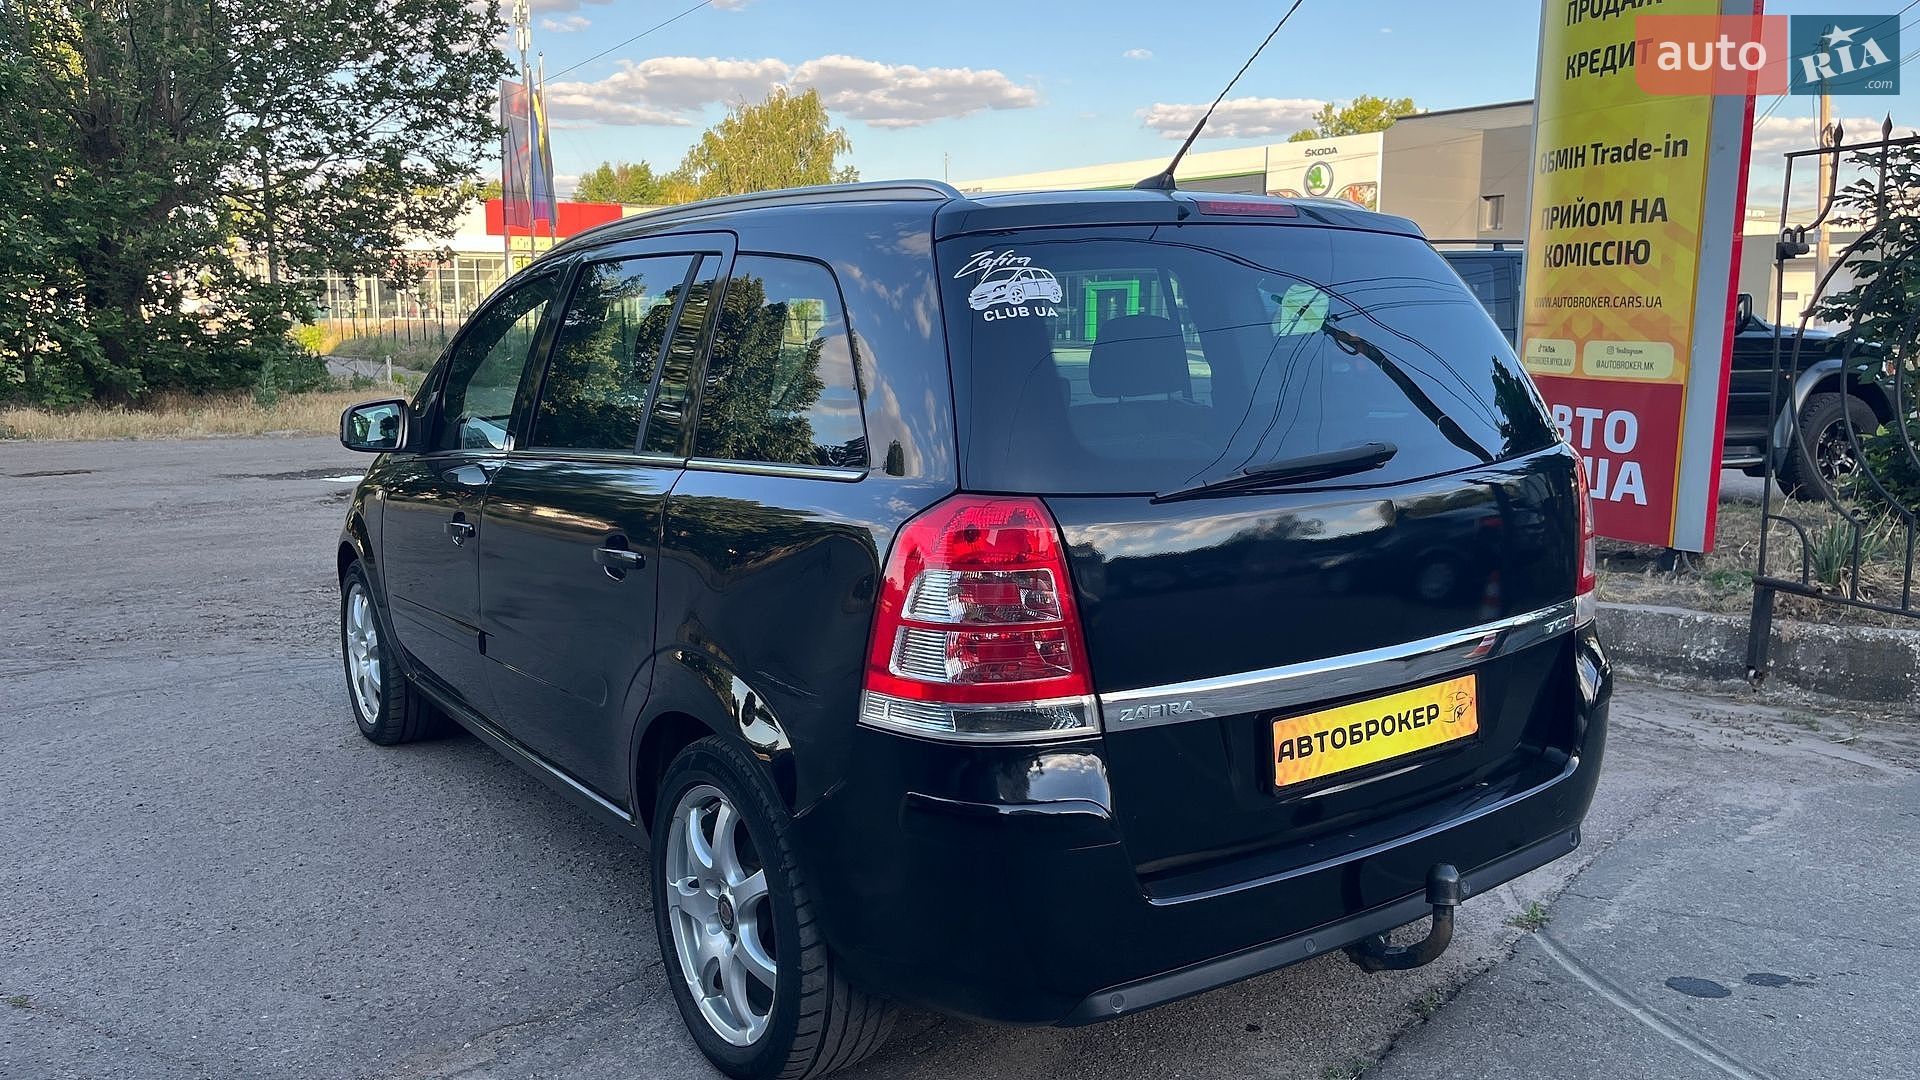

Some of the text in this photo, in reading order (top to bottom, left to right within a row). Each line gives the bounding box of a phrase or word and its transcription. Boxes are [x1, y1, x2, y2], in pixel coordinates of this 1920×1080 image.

[1566, 0, 1664, 27] ПРОД
[1565, 37, 1654, 80] КРЕДИТ
[1304, 146, 1338, 158] ŠKODA
[1540, 133, 1689, 174] ОБМІН Trade-in
[1541, 196, 1668, 231] ПРИЙОМ НА
[953, 249, 1032, 281] Zafira
[1543, 239, 1651, 268] КОМІССІЮ
[983, 306, 1059, 322] CLUB UA
[1534, 295, 1663, 309] WWW.AUTOBROKER.CARS.UA
[1552, 404, 1638, 454] ВТО
[1119, 700, 1193, 721] ZAFIRA
[1277, 703, 1440, 764] АВТОБРОКЕР
